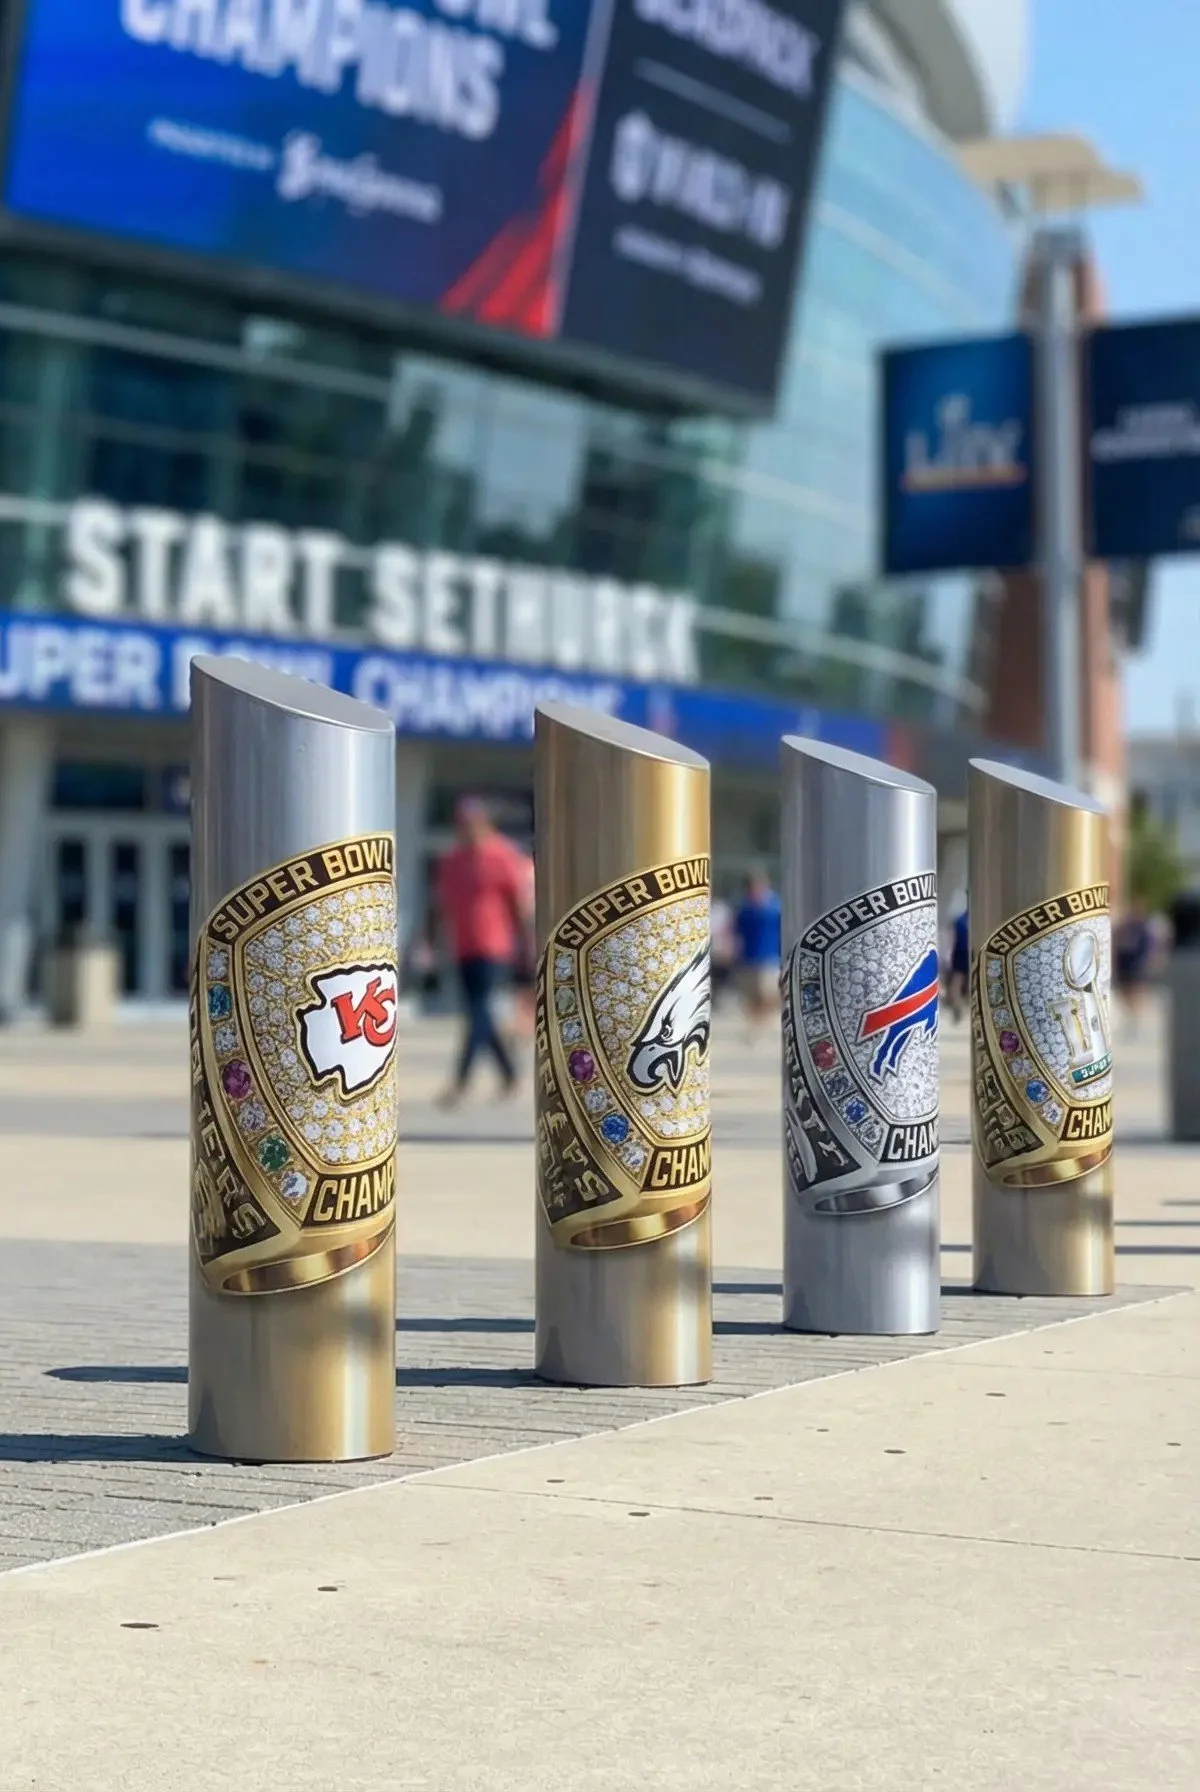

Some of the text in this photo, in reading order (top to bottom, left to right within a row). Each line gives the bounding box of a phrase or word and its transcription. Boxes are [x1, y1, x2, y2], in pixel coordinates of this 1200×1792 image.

[65, 498, 349, 638] START
[212, 839, 392, 940] SUPER BOWL
[558, 859, 709, 946] SUPER BOWL
[805, 890, 890, 950] SUPER
[990, 902, 1065, 953] SUPER
[313, 1156, 395, 1222] CHAMP
